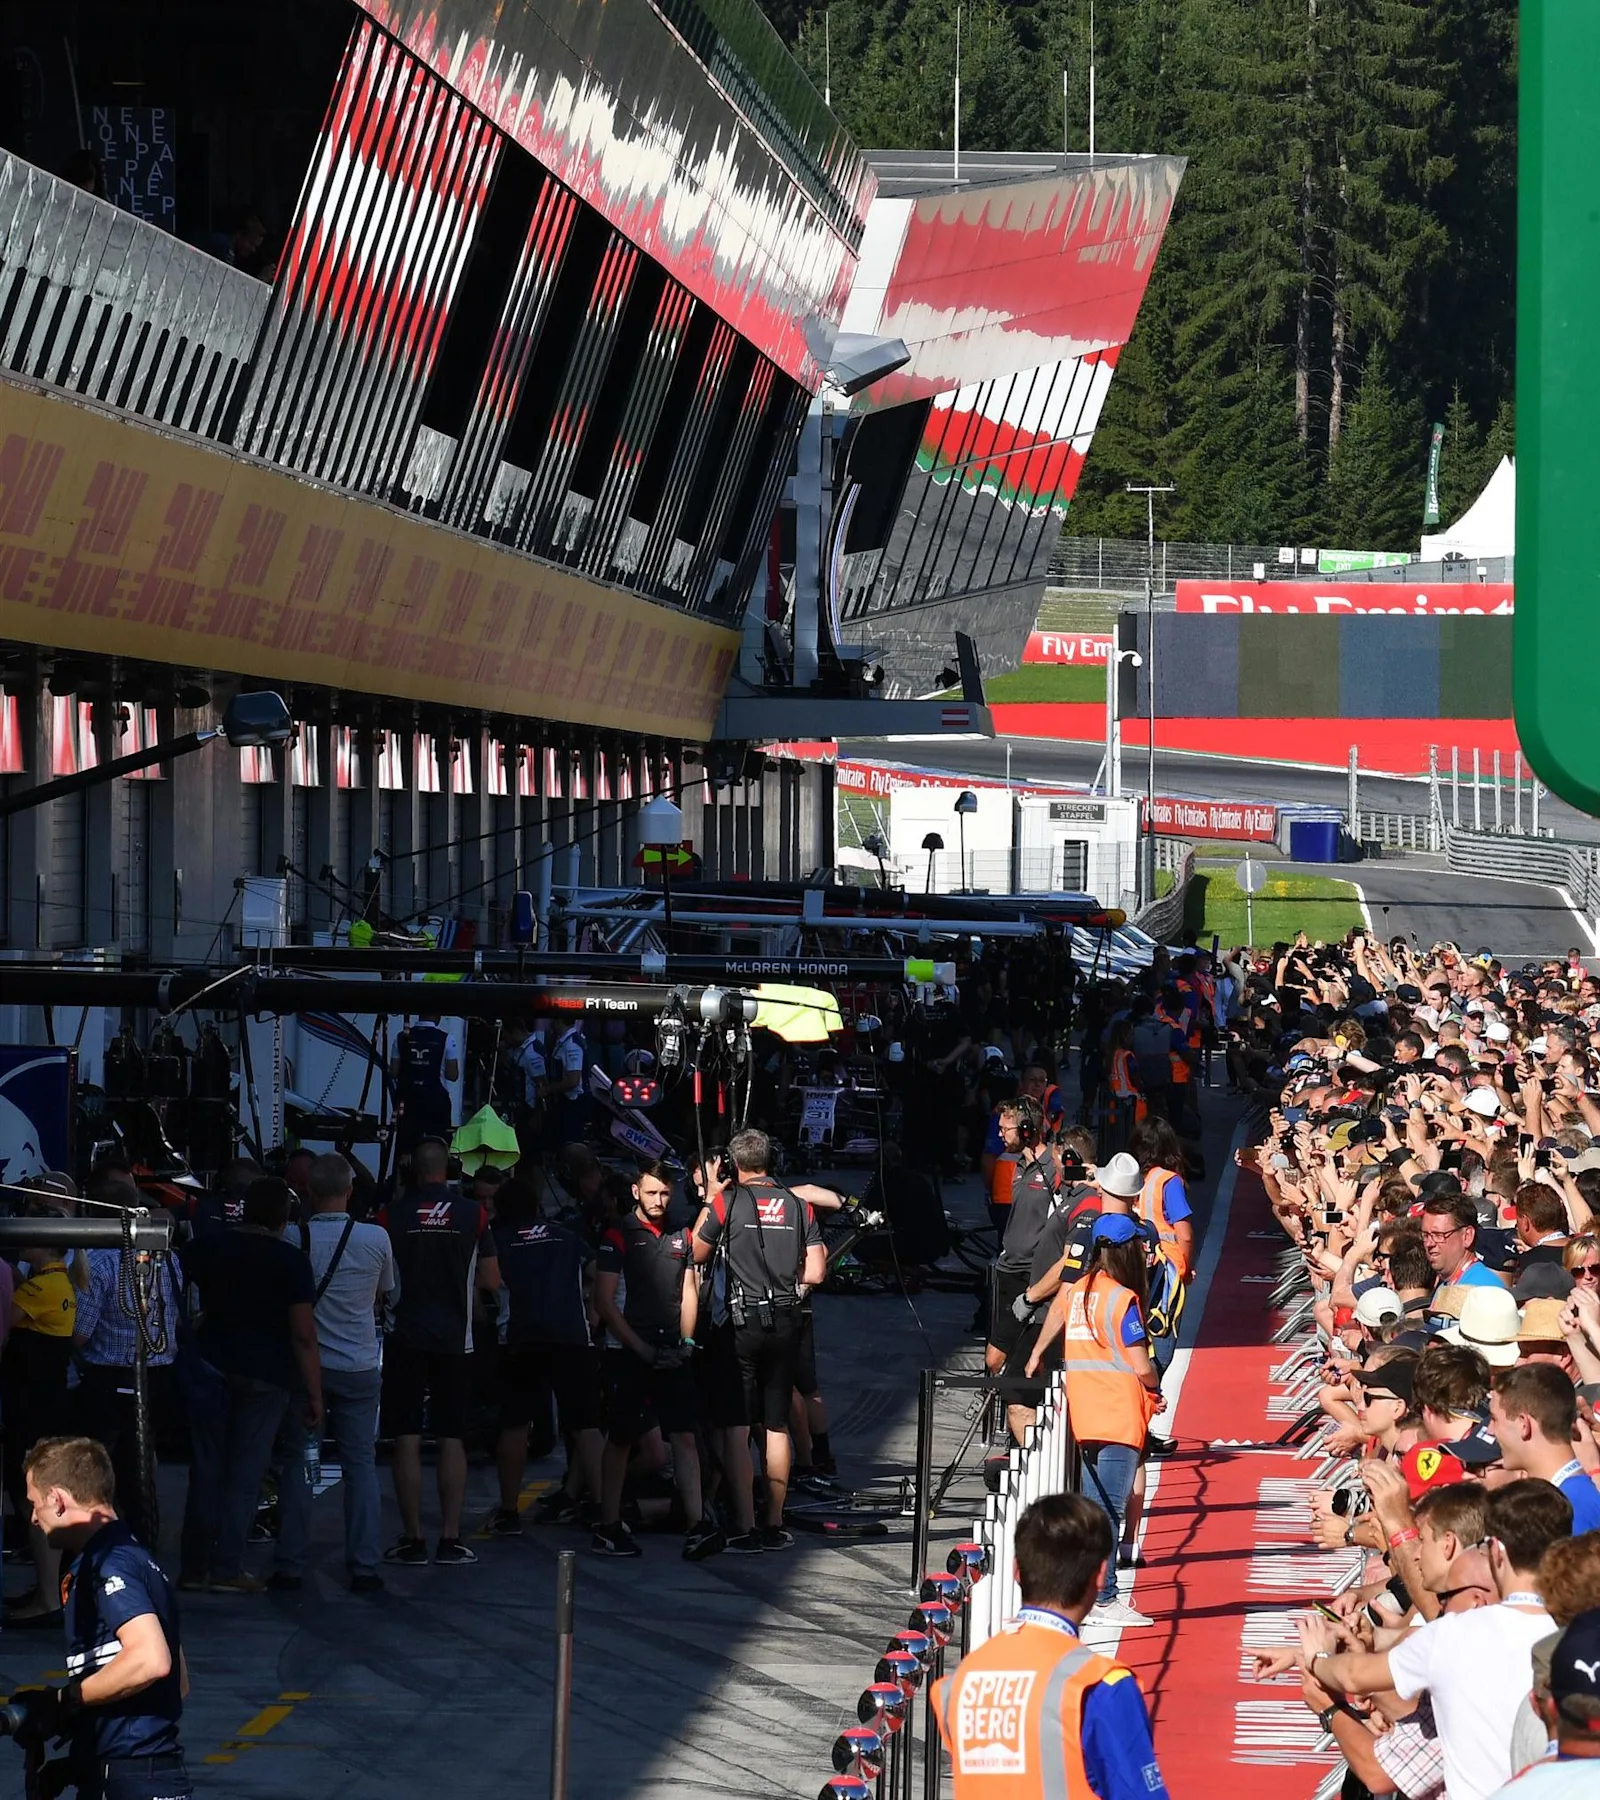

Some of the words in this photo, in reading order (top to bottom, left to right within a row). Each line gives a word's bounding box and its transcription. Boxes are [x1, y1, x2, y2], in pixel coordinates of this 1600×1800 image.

[1042, 637, 1075, 660] Fly
[1057, 803, 1098, 813] STRECKEN
[1060, 811, 1095, 821] STAFFEL
[725, 962, 791, 974] McLAREN
[798, 963, 849, 976] HONDA
[550, 998, 583, 1009] Haas
[584, 998, 601, 1009] F1
[602, 998, 638, 1011] Team
[806, 1111, 830, 1119] 31
[963, 1676, 1026, 1706] SPIEL
[962, 1707, 1017, 1740] BERG
